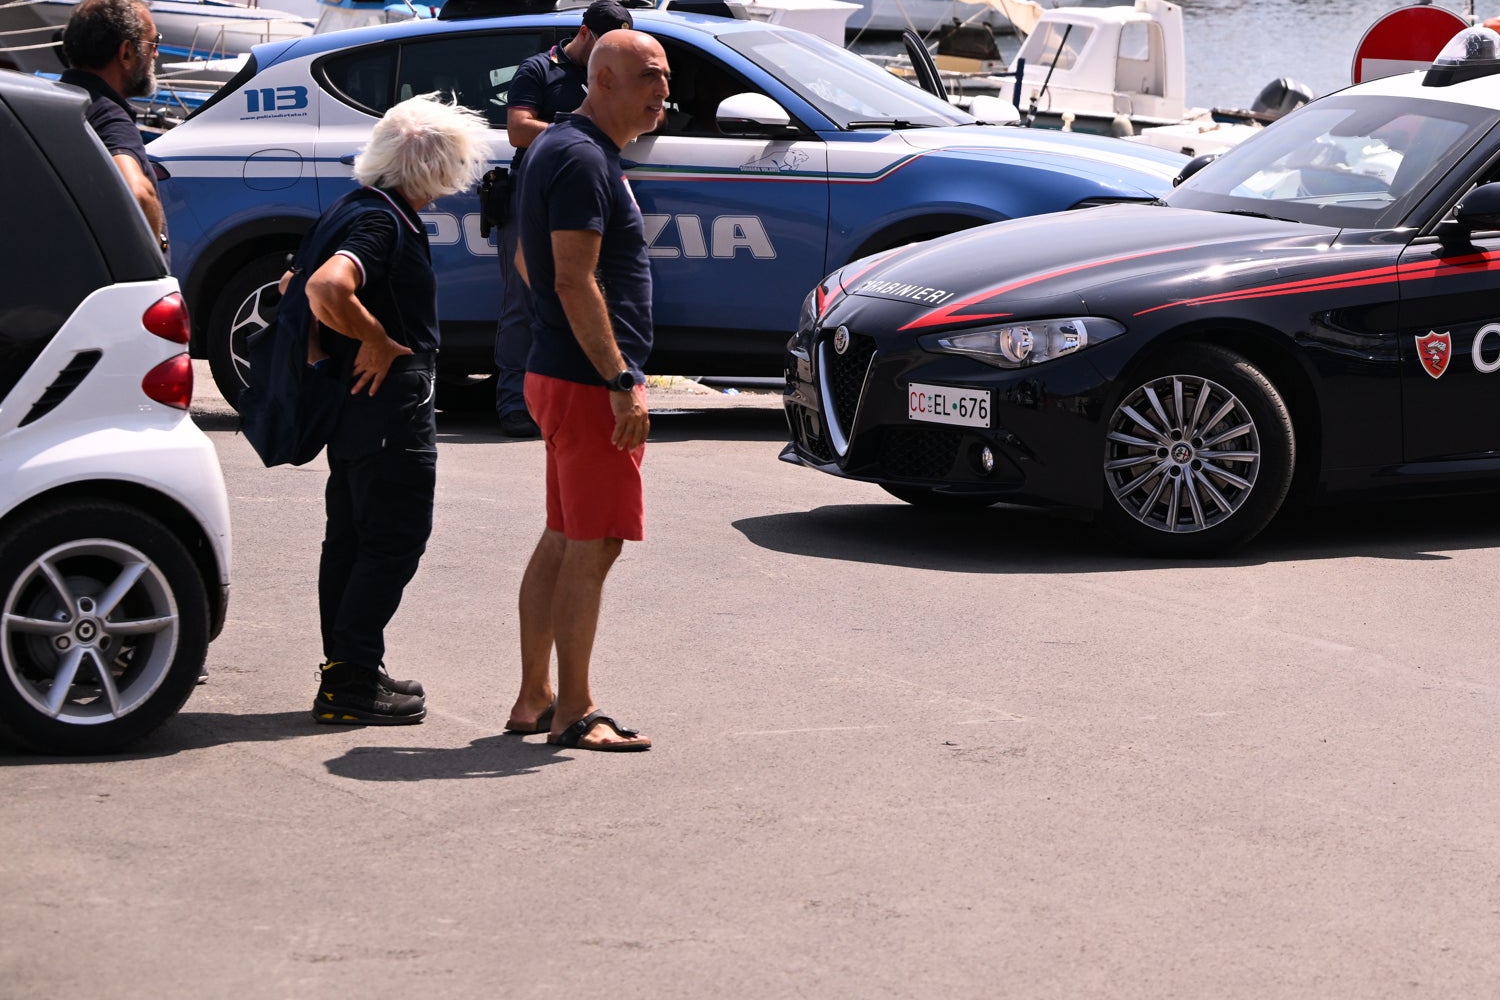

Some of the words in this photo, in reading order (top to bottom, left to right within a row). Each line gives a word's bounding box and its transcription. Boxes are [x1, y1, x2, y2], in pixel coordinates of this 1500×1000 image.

[244, 85, 309, 113] 113
[910, 391, 927, 413] CC
[934, 394, 951, 416] EL
[959, 397, 989, 420] 676
